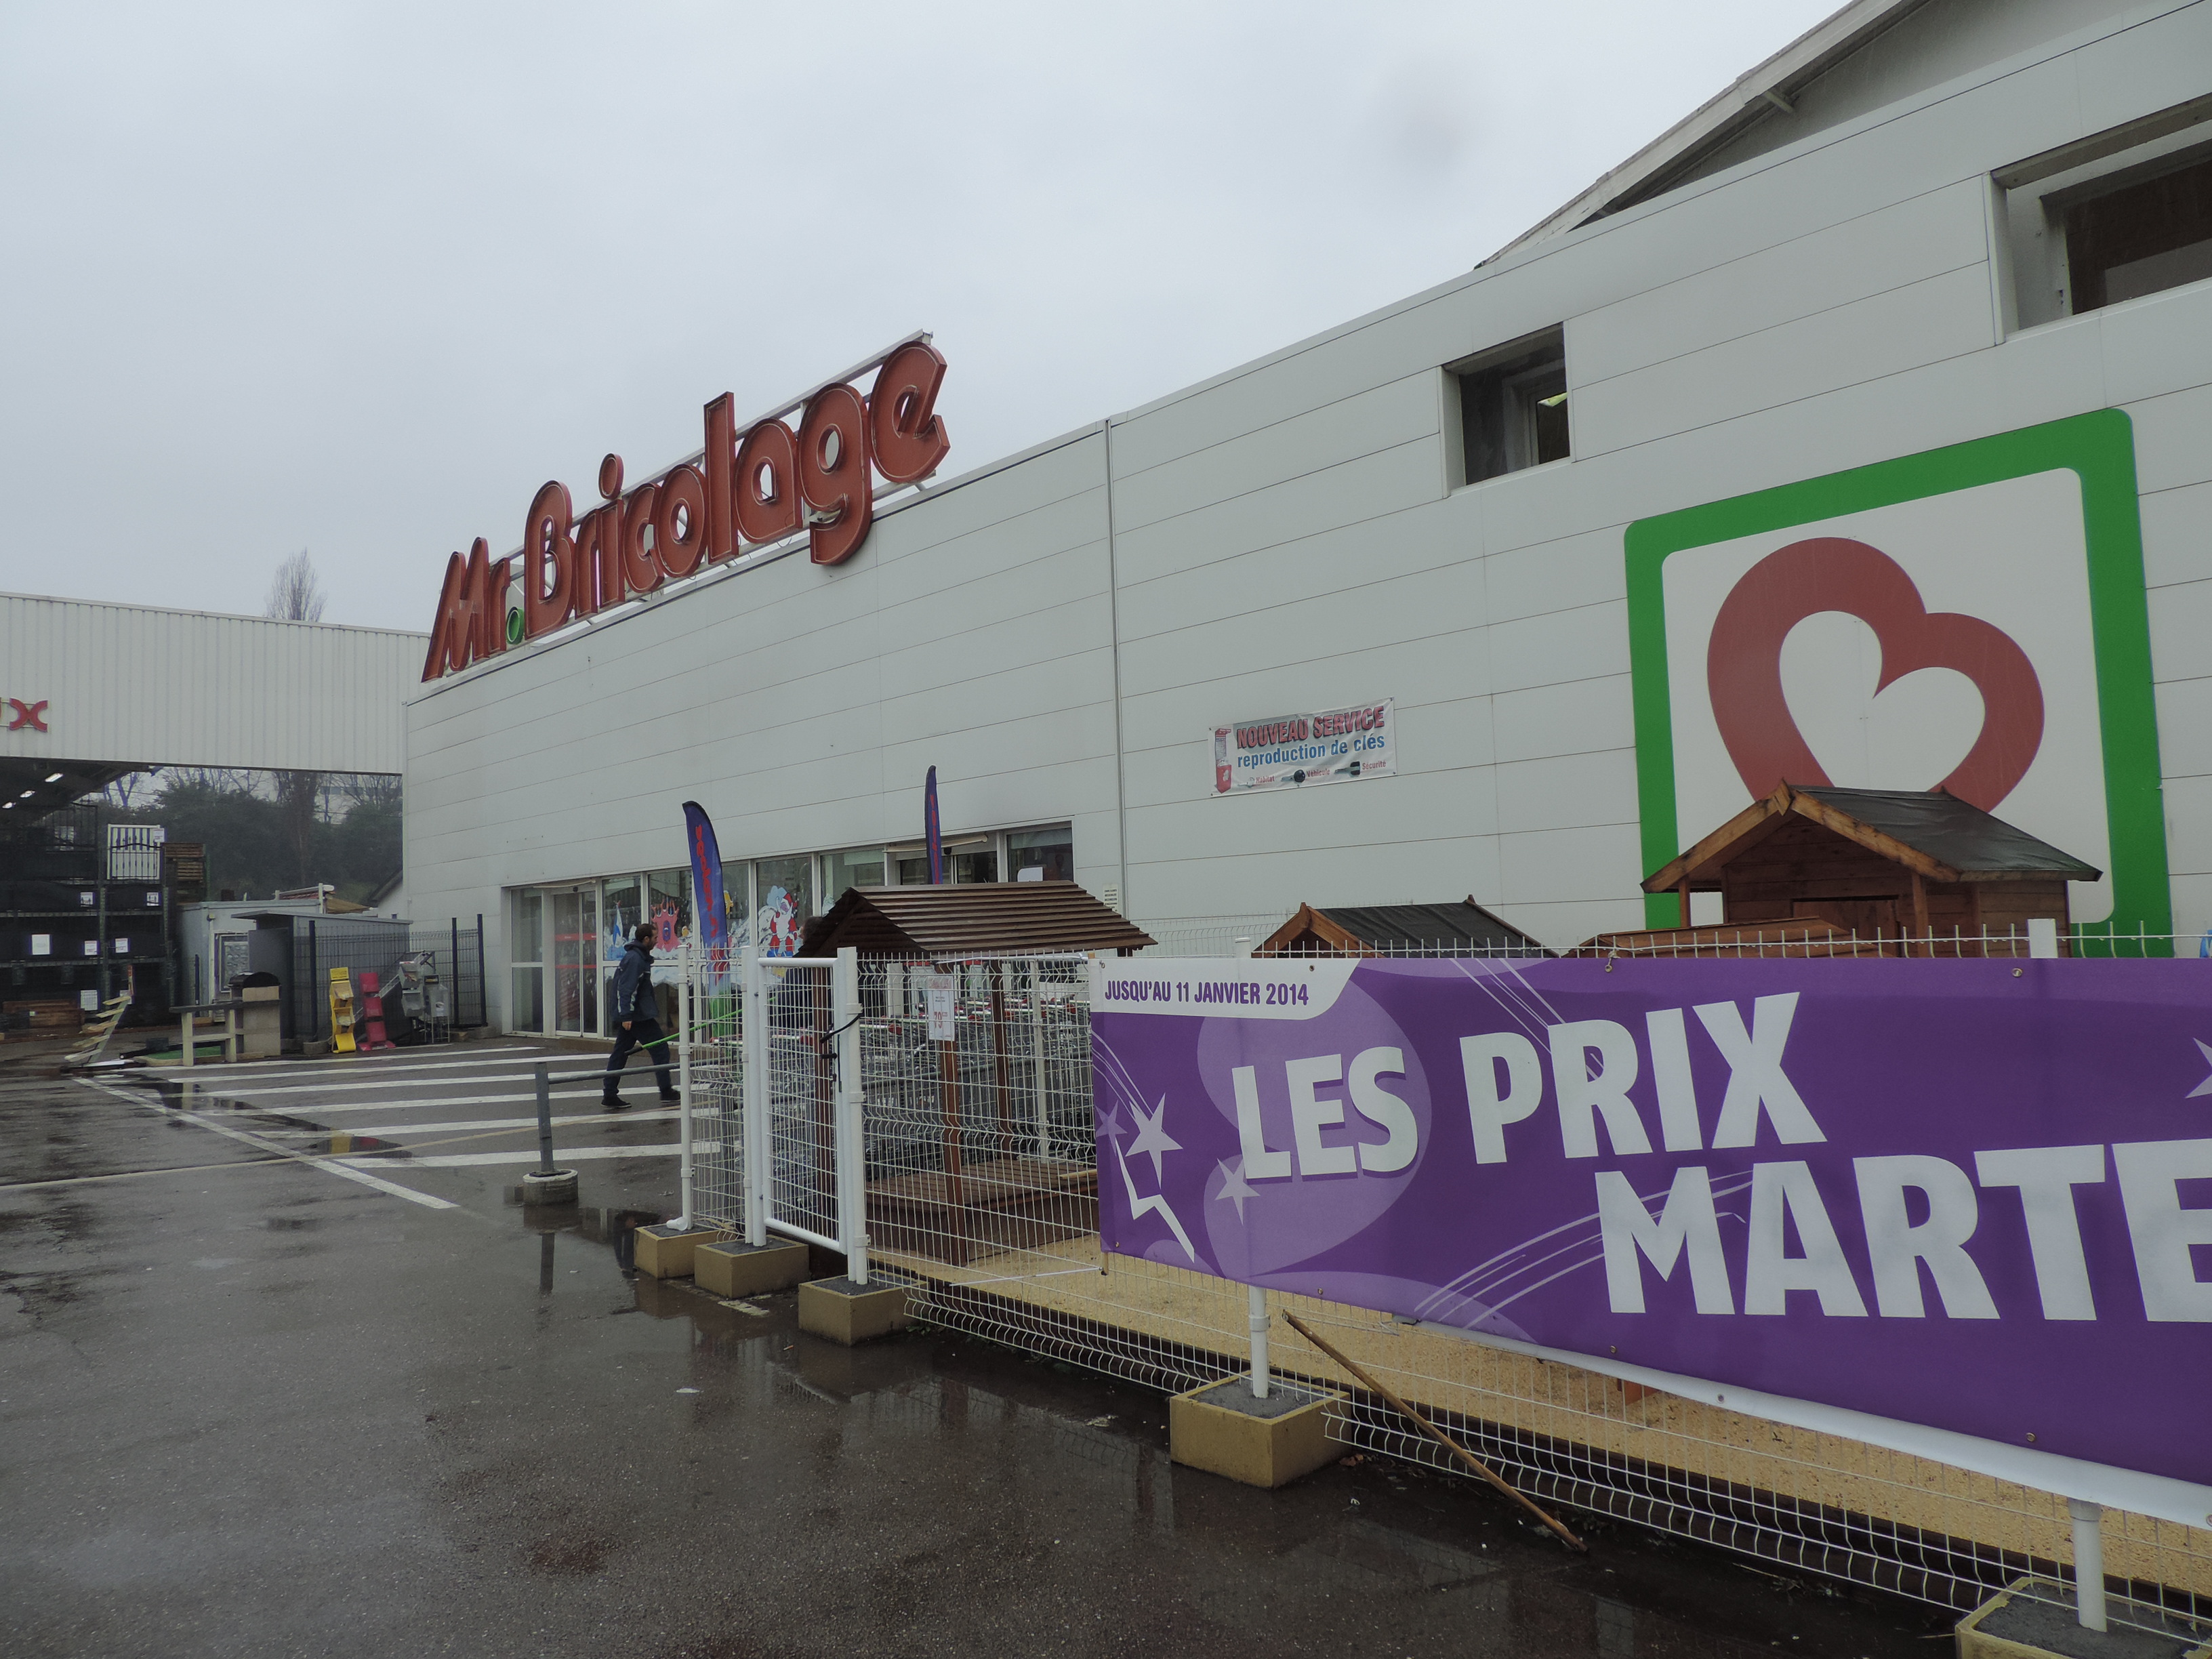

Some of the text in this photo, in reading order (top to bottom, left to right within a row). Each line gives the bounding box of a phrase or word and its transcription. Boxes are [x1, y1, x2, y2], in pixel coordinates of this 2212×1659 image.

[1237, 705, 1385, 749] NOUVEAU SERVICE
[1237, 733, 1385, 769] reproduction de clés
[1362, 759, 1387, 770] Sécurité
[1256, 775, 1275, 784] Habitat
[1306, 767, 1330, 777] Véhicule
[1105, 980, 1309, 1006] JUSQU'AU 11 JANVIER 2014
[1231, 991, 1827, 1183] LES PRIX
[1595, 1139, 2212, 1322] MARTE
